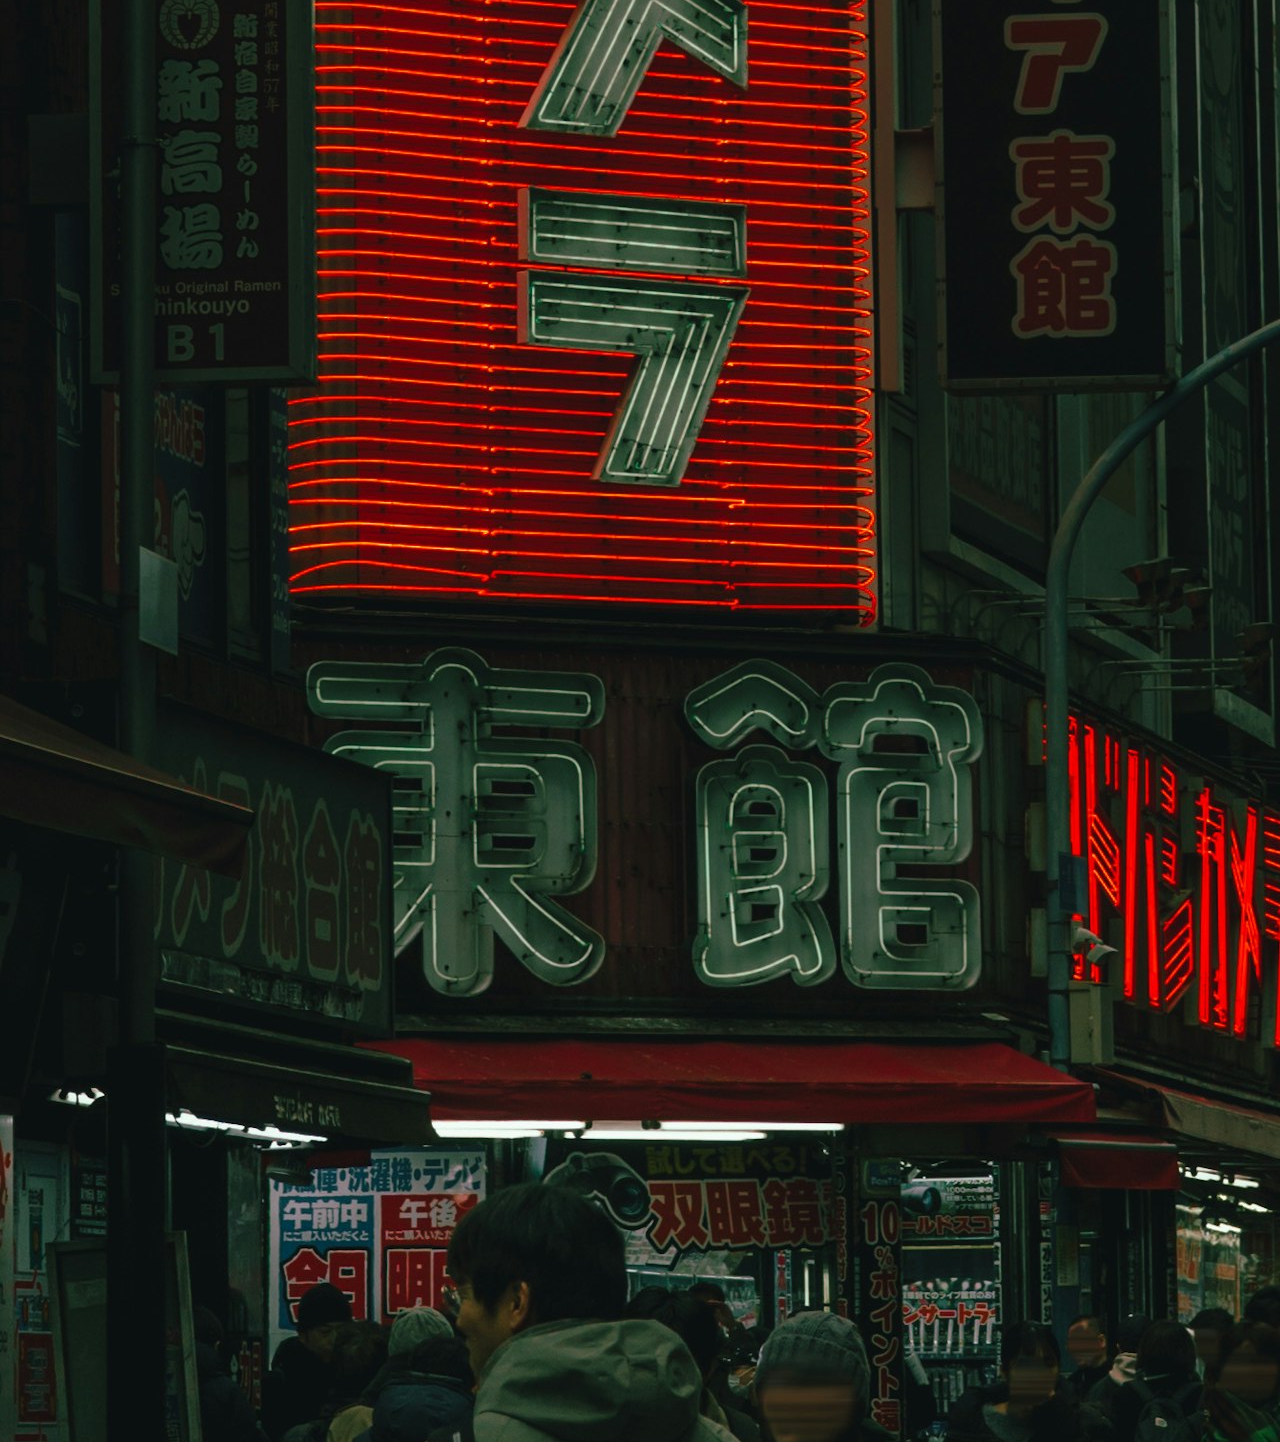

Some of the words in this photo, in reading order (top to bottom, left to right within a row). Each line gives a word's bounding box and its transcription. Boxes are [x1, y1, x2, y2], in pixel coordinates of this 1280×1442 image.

[233, 13, 260, 260] 新宿自家製らーめん
[1007, 128, 1117, 341] 東館
[174, 279, 230, 295] Original
[233, 278, 282, 294] Ramen
[166, 322, 228, 363] B1
[306, 644, 984, 1000] 東館
[153, 755, 383, 992] メラ総合館
[273, 1157, 482, 1194] 庫・洗濯機・テレビ
[644, 1145, 807, 1176] 試して選べる!
[283, 1199, 369, 1230] 午前中
[398, 1198, 458, 1229] 午後
[282, 1230, 370, 1243] にご購入いただくと
[282, 1247, 369, 1324] 今日
